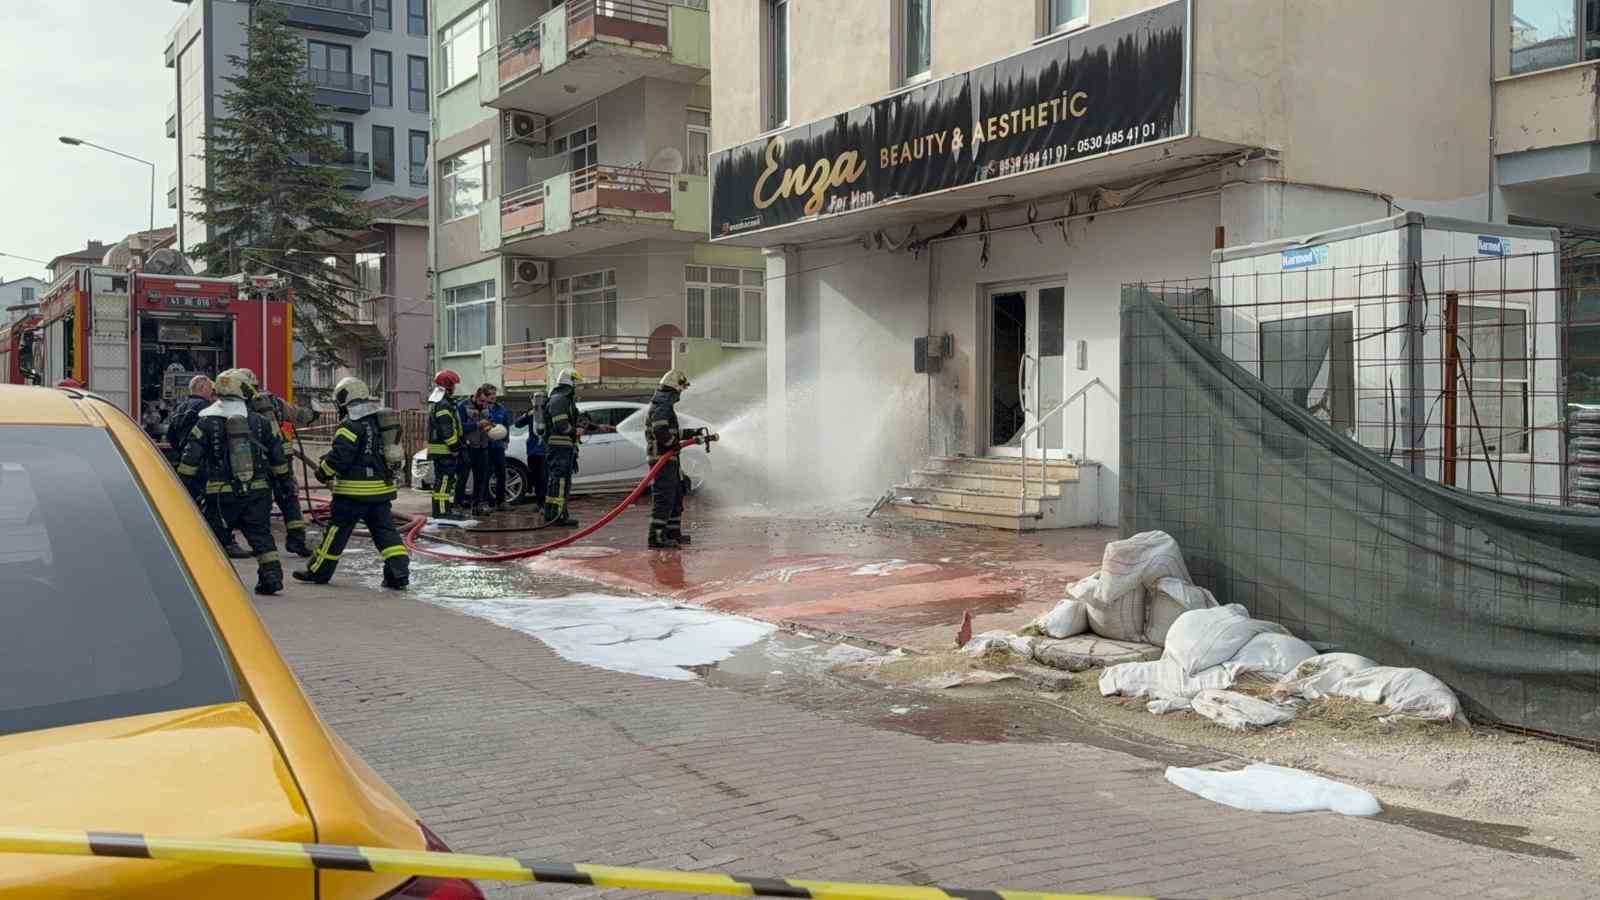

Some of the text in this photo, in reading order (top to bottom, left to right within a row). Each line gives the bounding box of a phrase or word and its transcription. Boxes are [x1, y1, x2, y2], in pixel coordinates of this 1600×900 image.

[880, 90, 1088, 169] BEAUTY & AESTHETİC
[1042, 147, 1053, 161] 41
[1056, 144, 1067, 160] 01
[1077, 136, 1102, 153] 0530
[1104, 130, 1124, 146] 485
[1127, 126, 1139, 140] 41
[1142, 122, 1156, 137] 01
[753, 135, 867, 216] Enza
[831, 195, 848, 209] For
